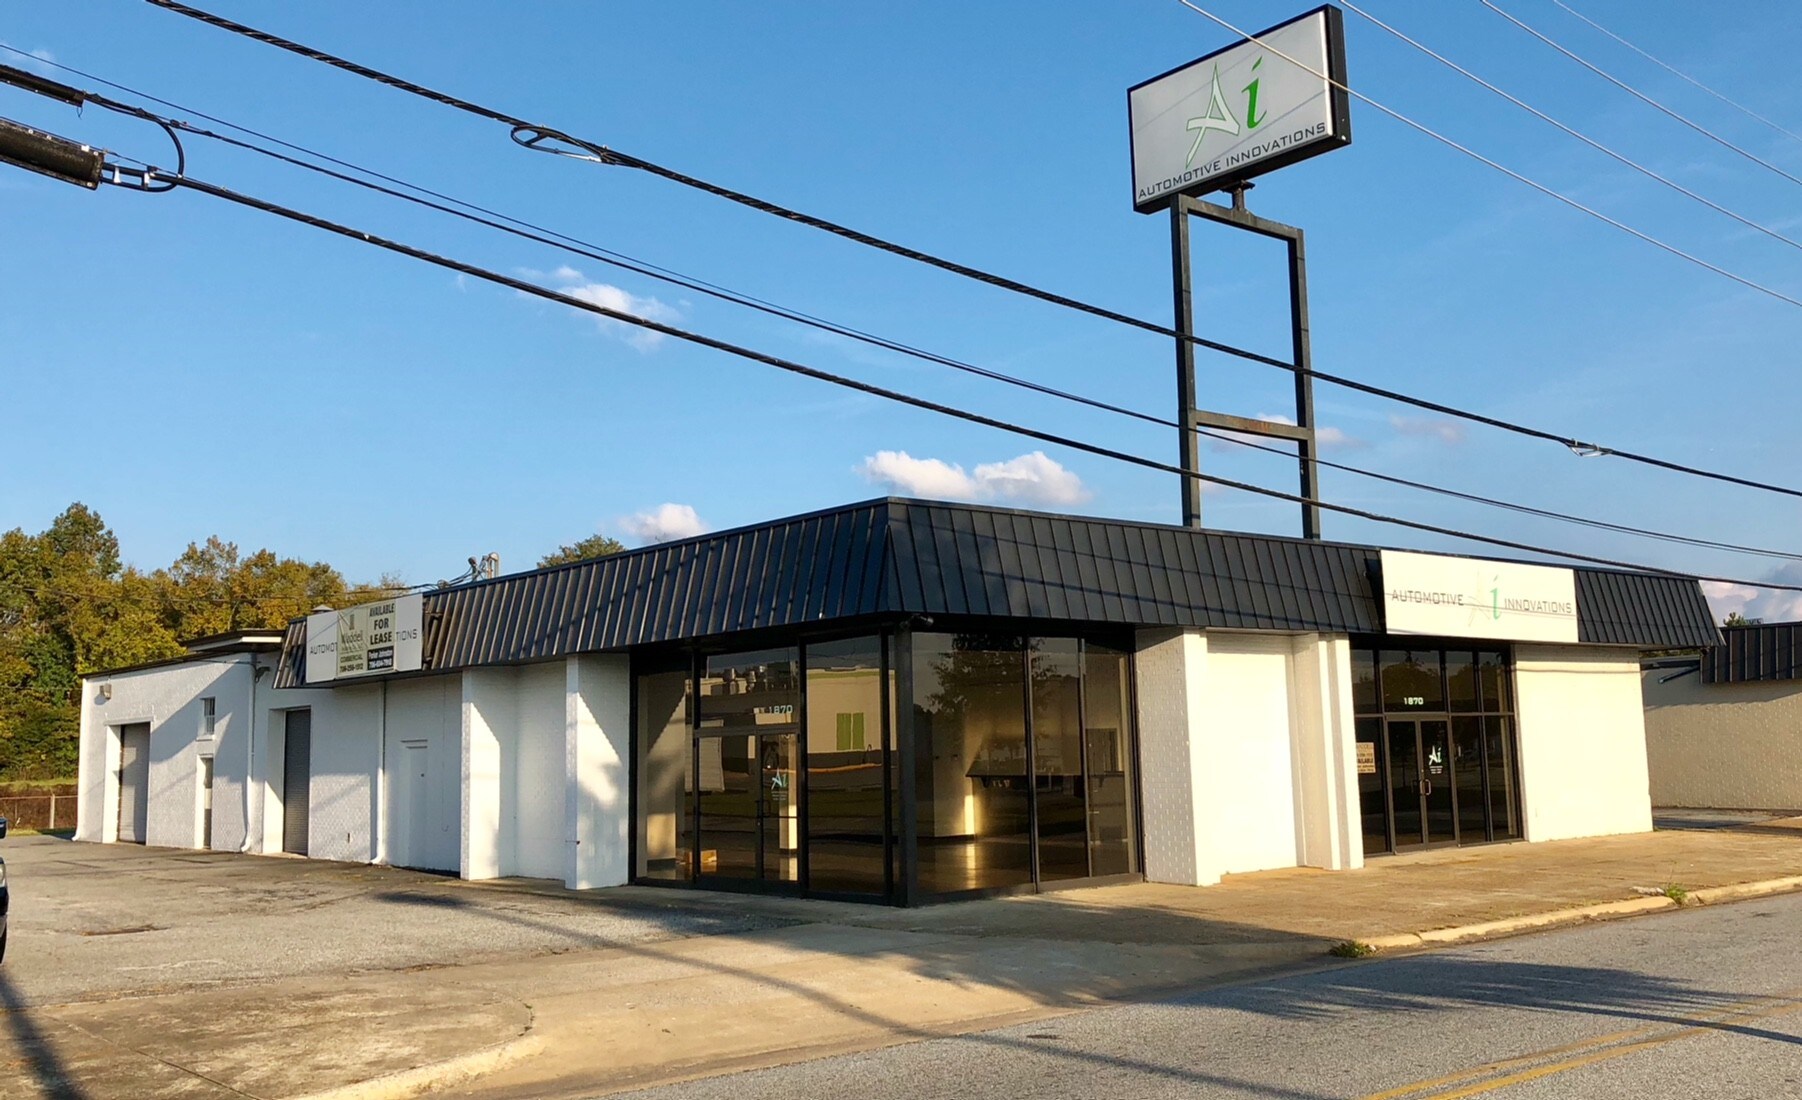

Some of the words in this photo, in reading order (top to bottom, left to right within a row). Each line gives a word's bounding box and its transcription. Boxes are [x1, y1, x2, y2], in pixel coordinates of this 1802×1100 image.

[1138, 160, 1221, 199] AUTOMOTIVE
[1226, 122, 1326, 167] INNOVATIONS
[1391, 589, 1465, 606] AUTOMOTIVE
[1504, 598, 1572, 614] INNOVATIONS
[370, 603, 394, 617] AVAILABLE
[374, 618, 389, 630] FOR
[370, 632, 392, 645] LEASE
[1403, 696, 1424, 705] 1870
[769, 705, 793, 714] 1870
